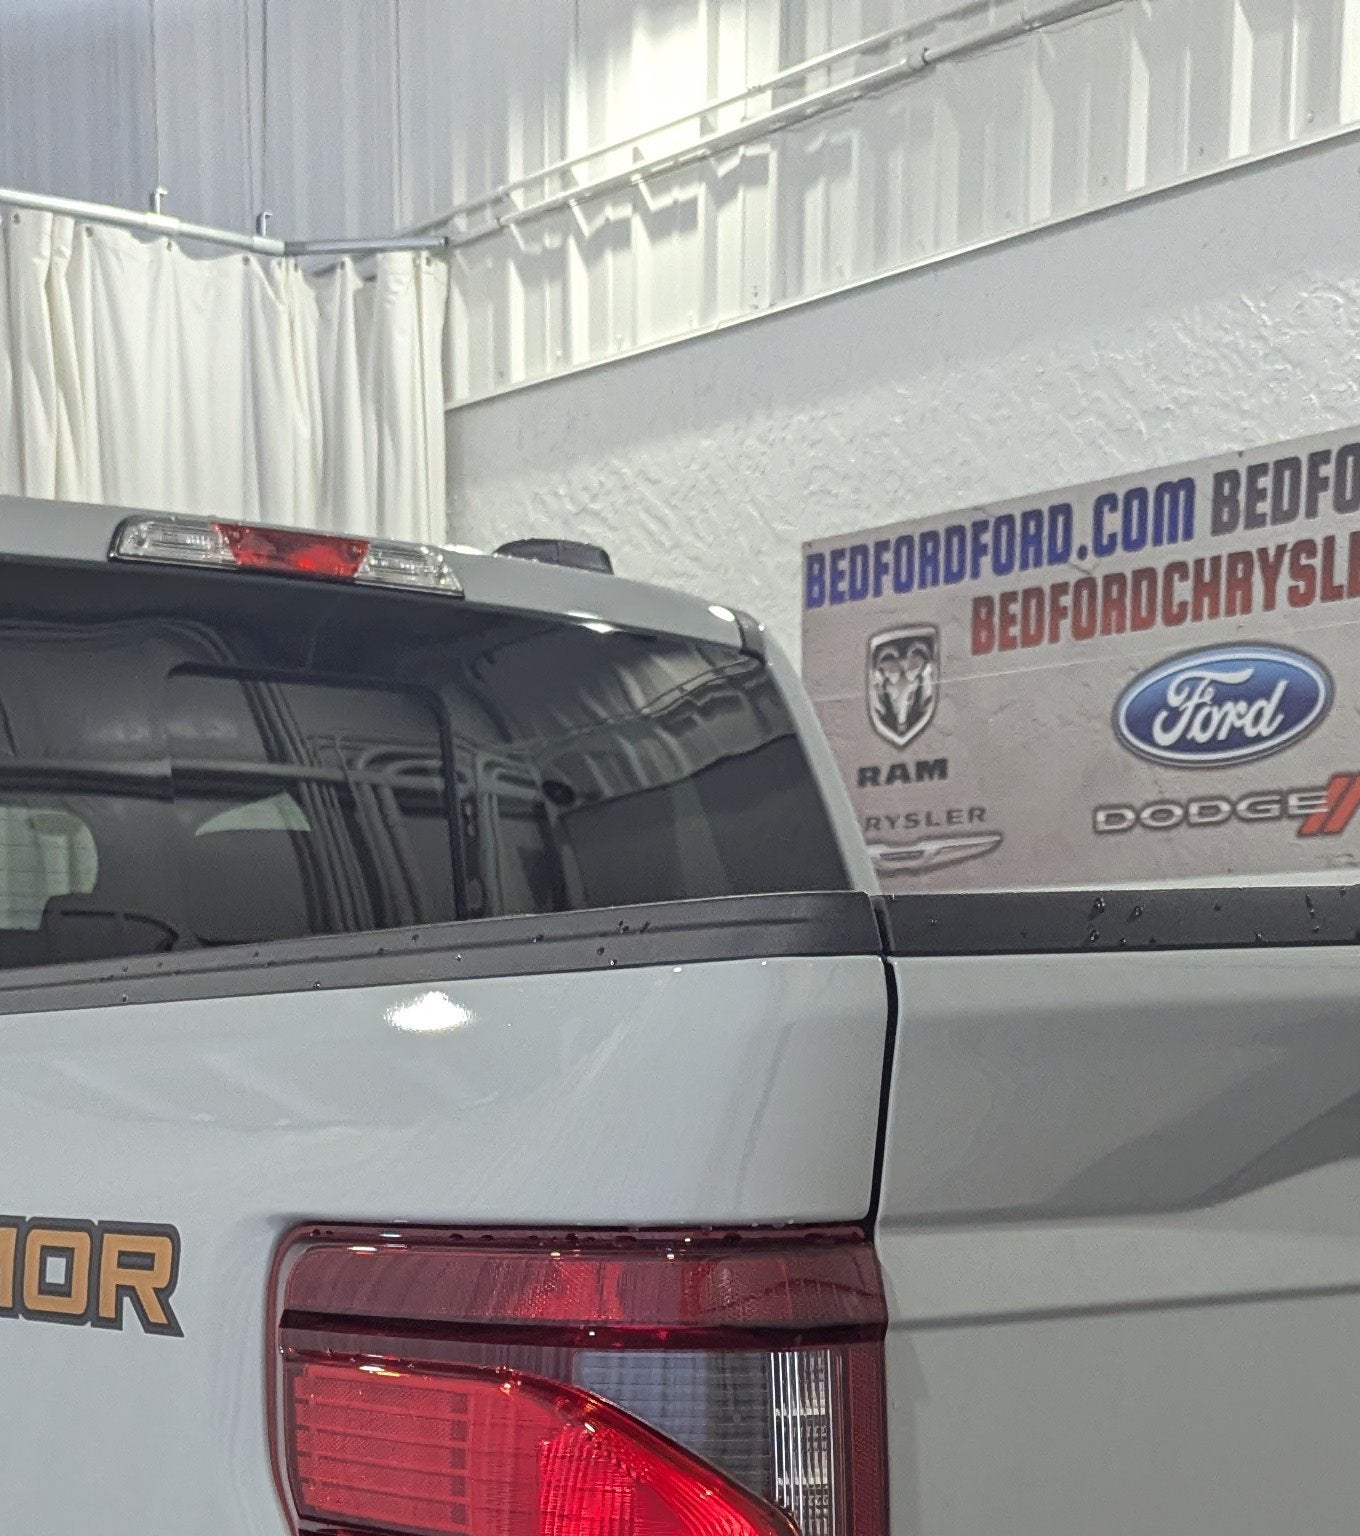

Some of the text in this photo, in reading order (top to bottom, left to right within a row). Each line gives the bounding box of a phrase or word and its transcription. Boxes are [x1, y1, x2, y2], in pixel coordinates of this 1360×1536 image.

[804, 476, 1196, 611] BEDFORDFORD.COM
[1151, 666, 1291, 748] Ford
[856, 757, 950, 789] RAM
[863, 806, 988, 833] RYSLER
[1091, 785, 1332, 835] DODGE
